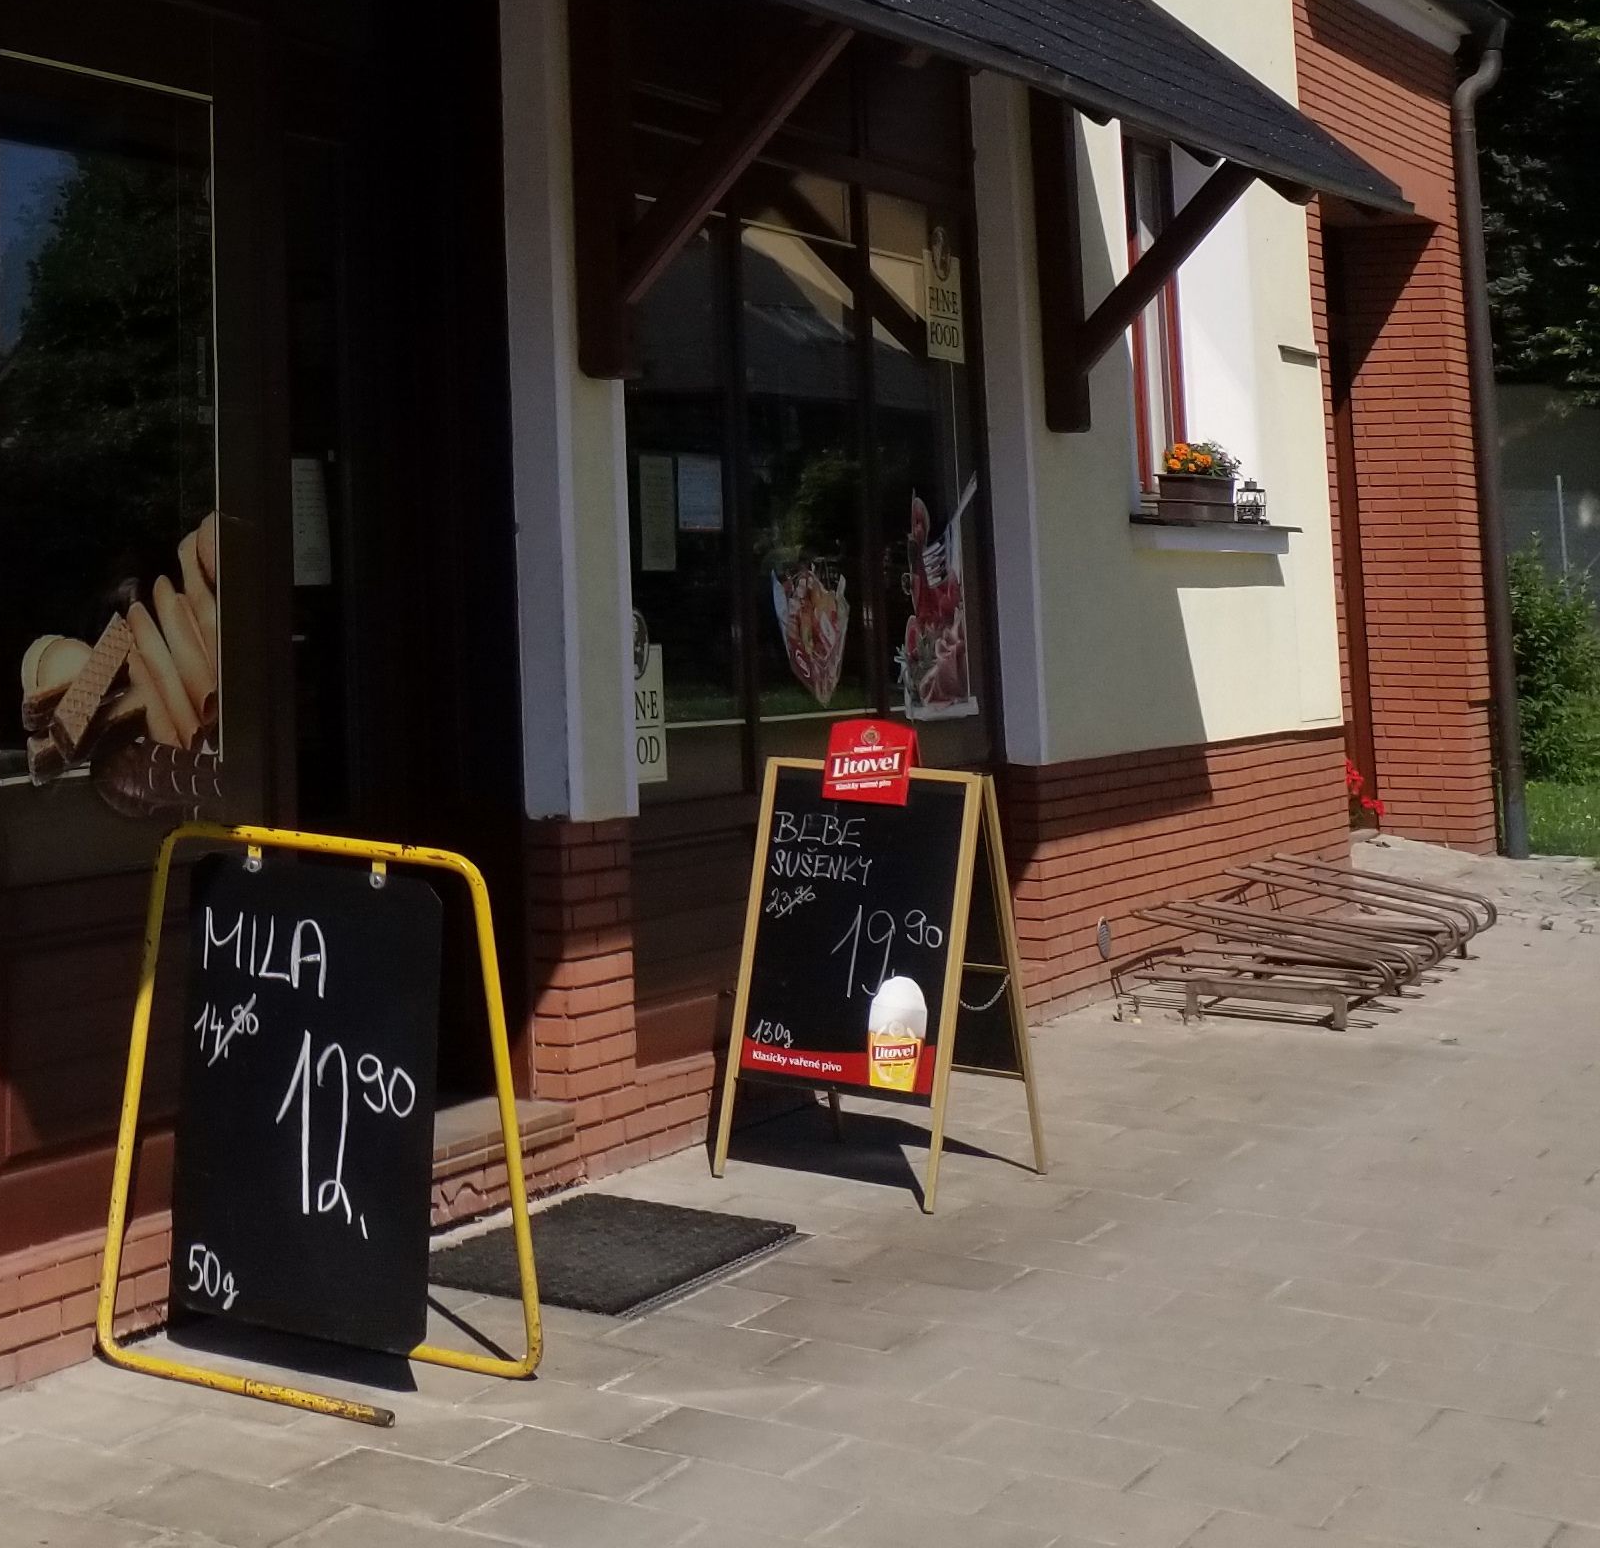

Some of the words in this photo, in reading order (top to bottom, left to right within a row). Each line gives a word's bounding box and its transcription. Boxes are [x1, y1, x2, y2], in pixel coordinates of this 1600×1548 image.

[930, 321, 959, 348] FOOD
[635, 735, 661, 765] OD
[832, 752, 901, 778] Litovel
[770, 846, 873, 886] SUŠENKY
[203, 905, 327, 999] MILA
[752, 1018, 794, 1049] 130g
[821, 1062, 842, 1073] pivo
[875, 1044, 915, 1061] Litovel
[187, 1244, 239, 1311] 50g
